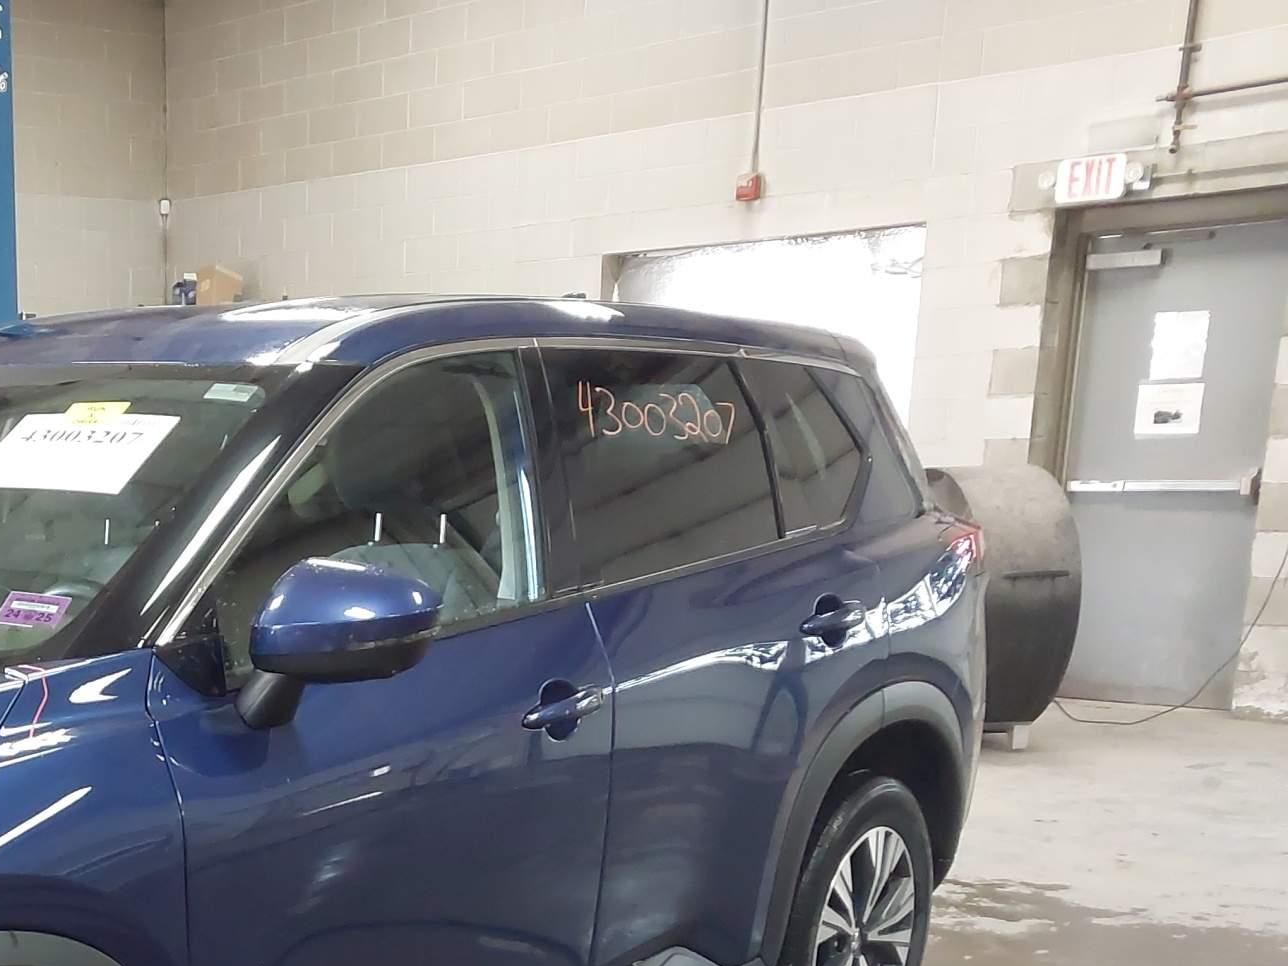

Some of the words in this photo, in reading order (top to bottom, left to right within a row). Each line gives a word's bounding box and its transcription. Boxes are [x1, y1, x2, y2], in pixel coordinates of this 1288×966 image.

[1068, 157, 1116, 198] EXIT
[578, 380, 736, 445] 43003207
[21, 429, 144, 445] 43003207
[3, 608, 22, 618] 24
[35, 612, 53, 623] 25
